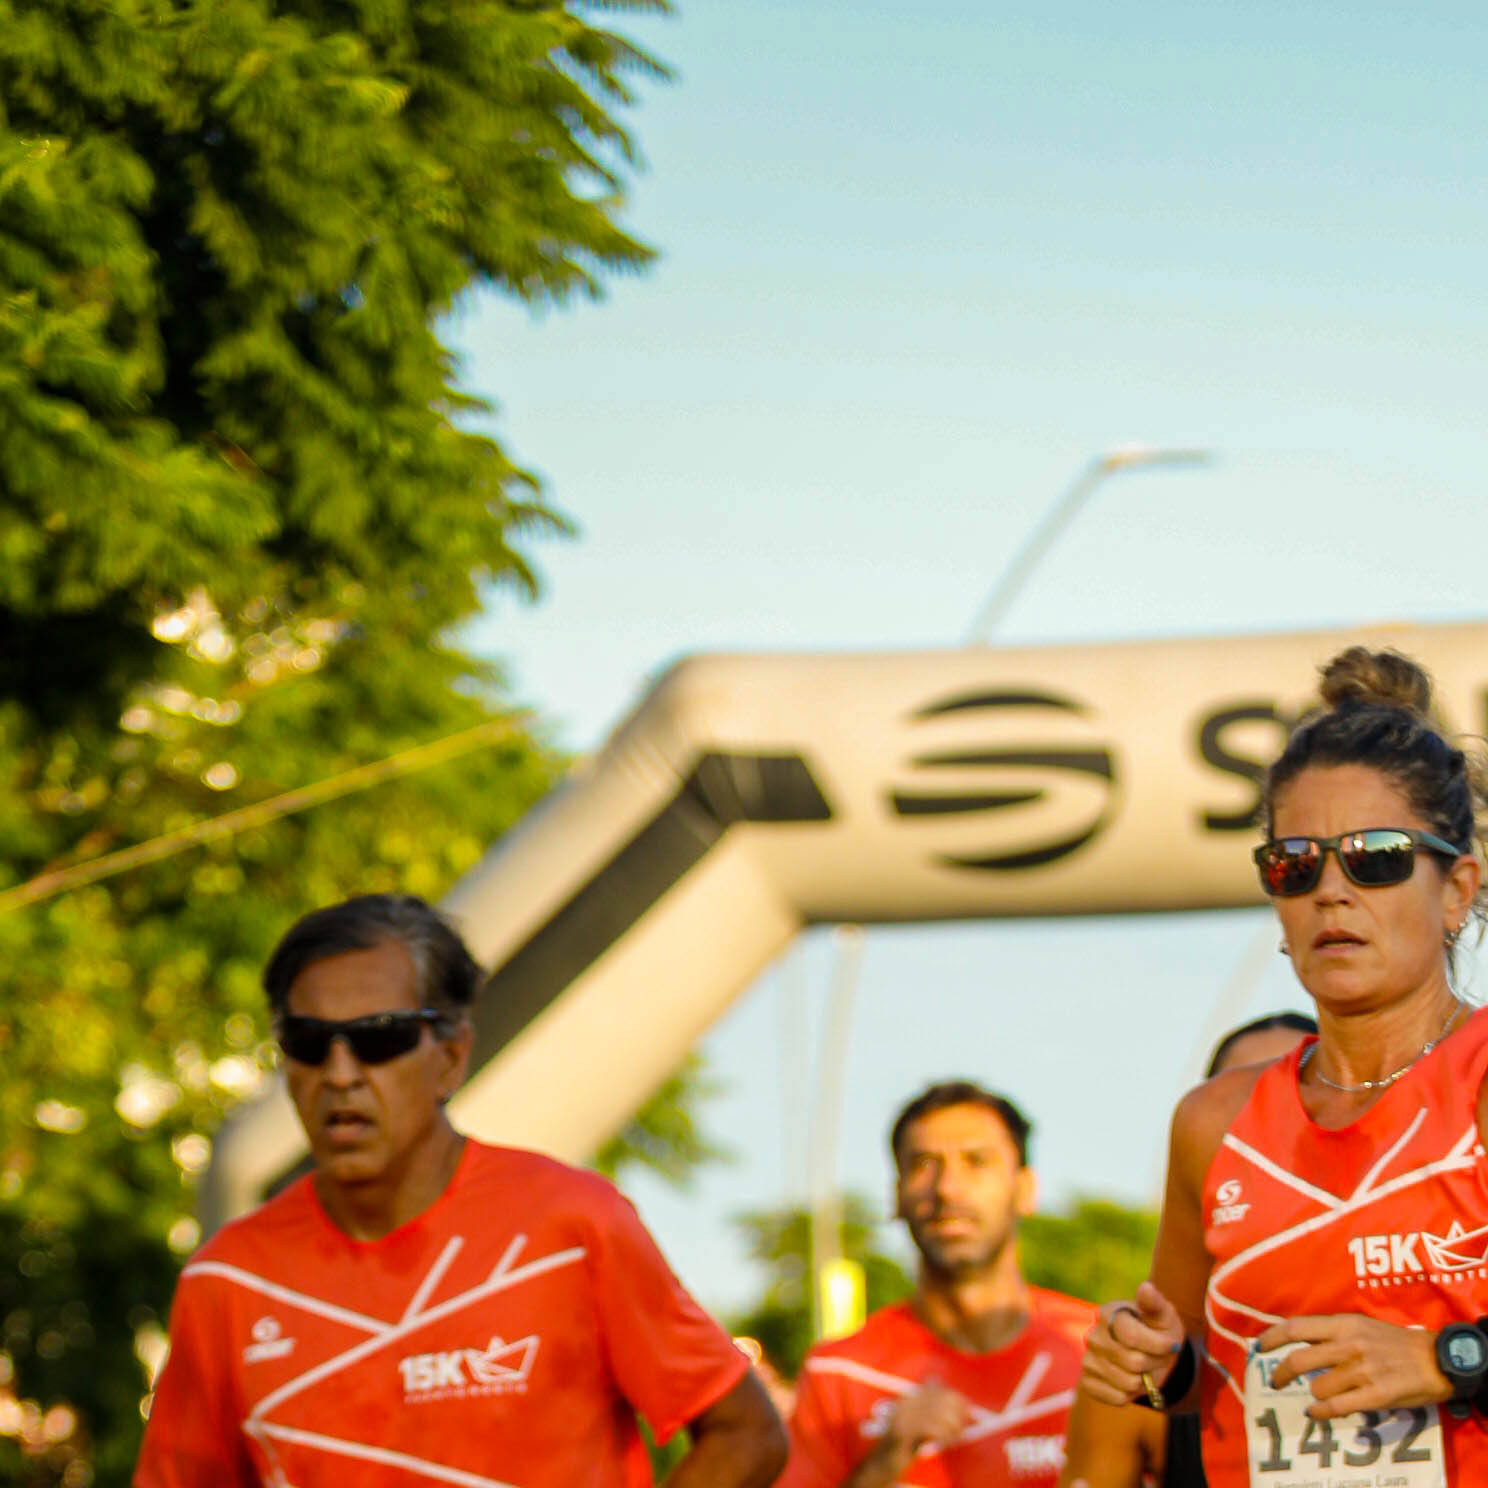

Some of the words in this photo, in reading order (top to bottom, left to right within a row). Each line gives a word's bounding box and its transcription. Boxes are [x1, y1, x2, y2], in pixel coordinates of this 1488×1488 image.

[1348, 1232, 1424, 1277] 15K
[398, 1349, 467, 1392] 15K
[1255, 1406, 1432, 1472] 1432
